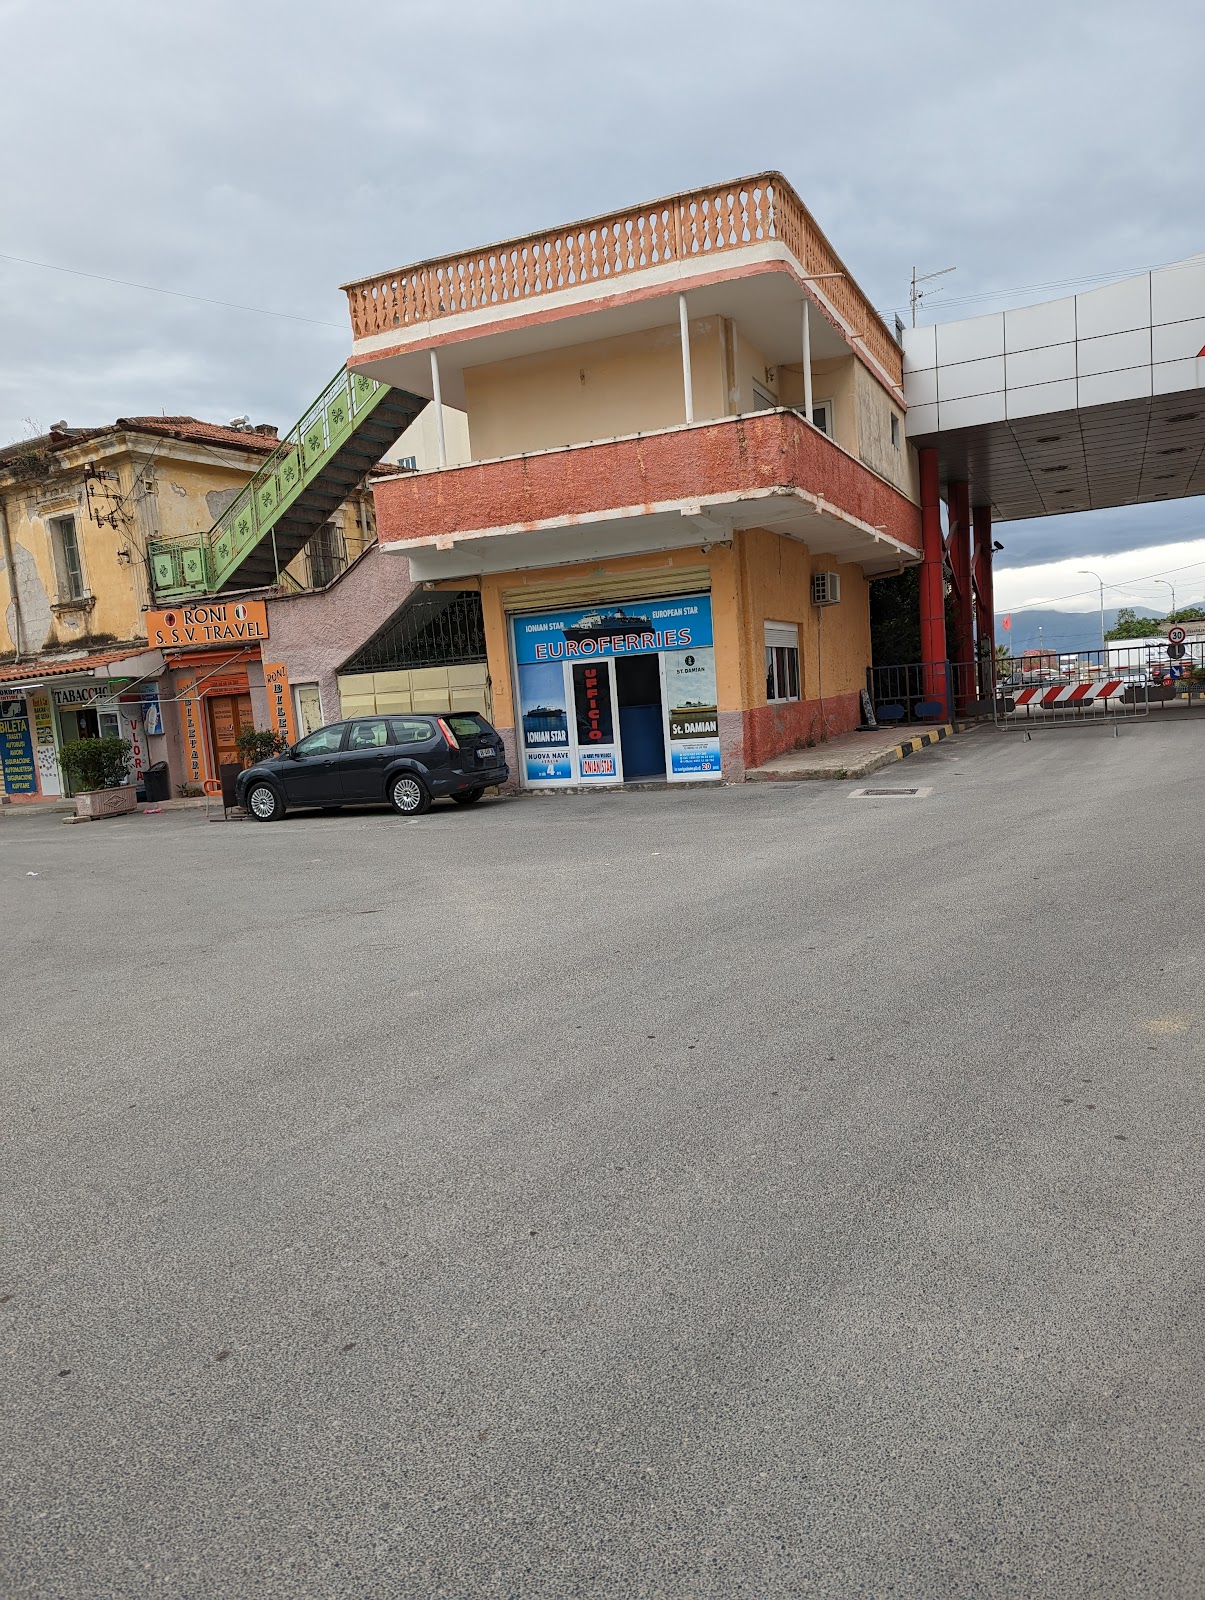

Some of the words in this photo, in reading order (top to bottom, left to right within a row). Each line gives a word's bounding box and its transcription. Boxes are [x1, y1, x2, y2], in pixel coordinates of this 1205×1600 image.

[183, 606, 228, 625] RONI
[652, 610, 683, 619] EUROPEAN
[683, 606, 698, 615] STAR
[203, 622, 264, 641] TRAVEL
[525, 623, 549, 633] IONIAN
[549, 621, 565, 630] STAR
[1172, 631, 1182, 640] 30
[535, 628, 692, 660] EUROFERRIES
[266, 666, 286, 684] RONI
[585, 669, 603, 740] UFFICIO
[0, 719, 27, 733] BILETA
[672, 723, 683, 734] St.
[684, 721, 717, 733] DAMIAN
[184, 697, 199, 780] BILETARI
[527, 731, 550, 743] IONIAN
[551, 730, 567, 741] STAR
[130, 720, 144, 781] VLORA
[546, 764, 555, 776] 4
[582, 760, 600, 774] IONIAN
[601, 759, 614, 773] STAR
[701, 762, 711, 771] 20
